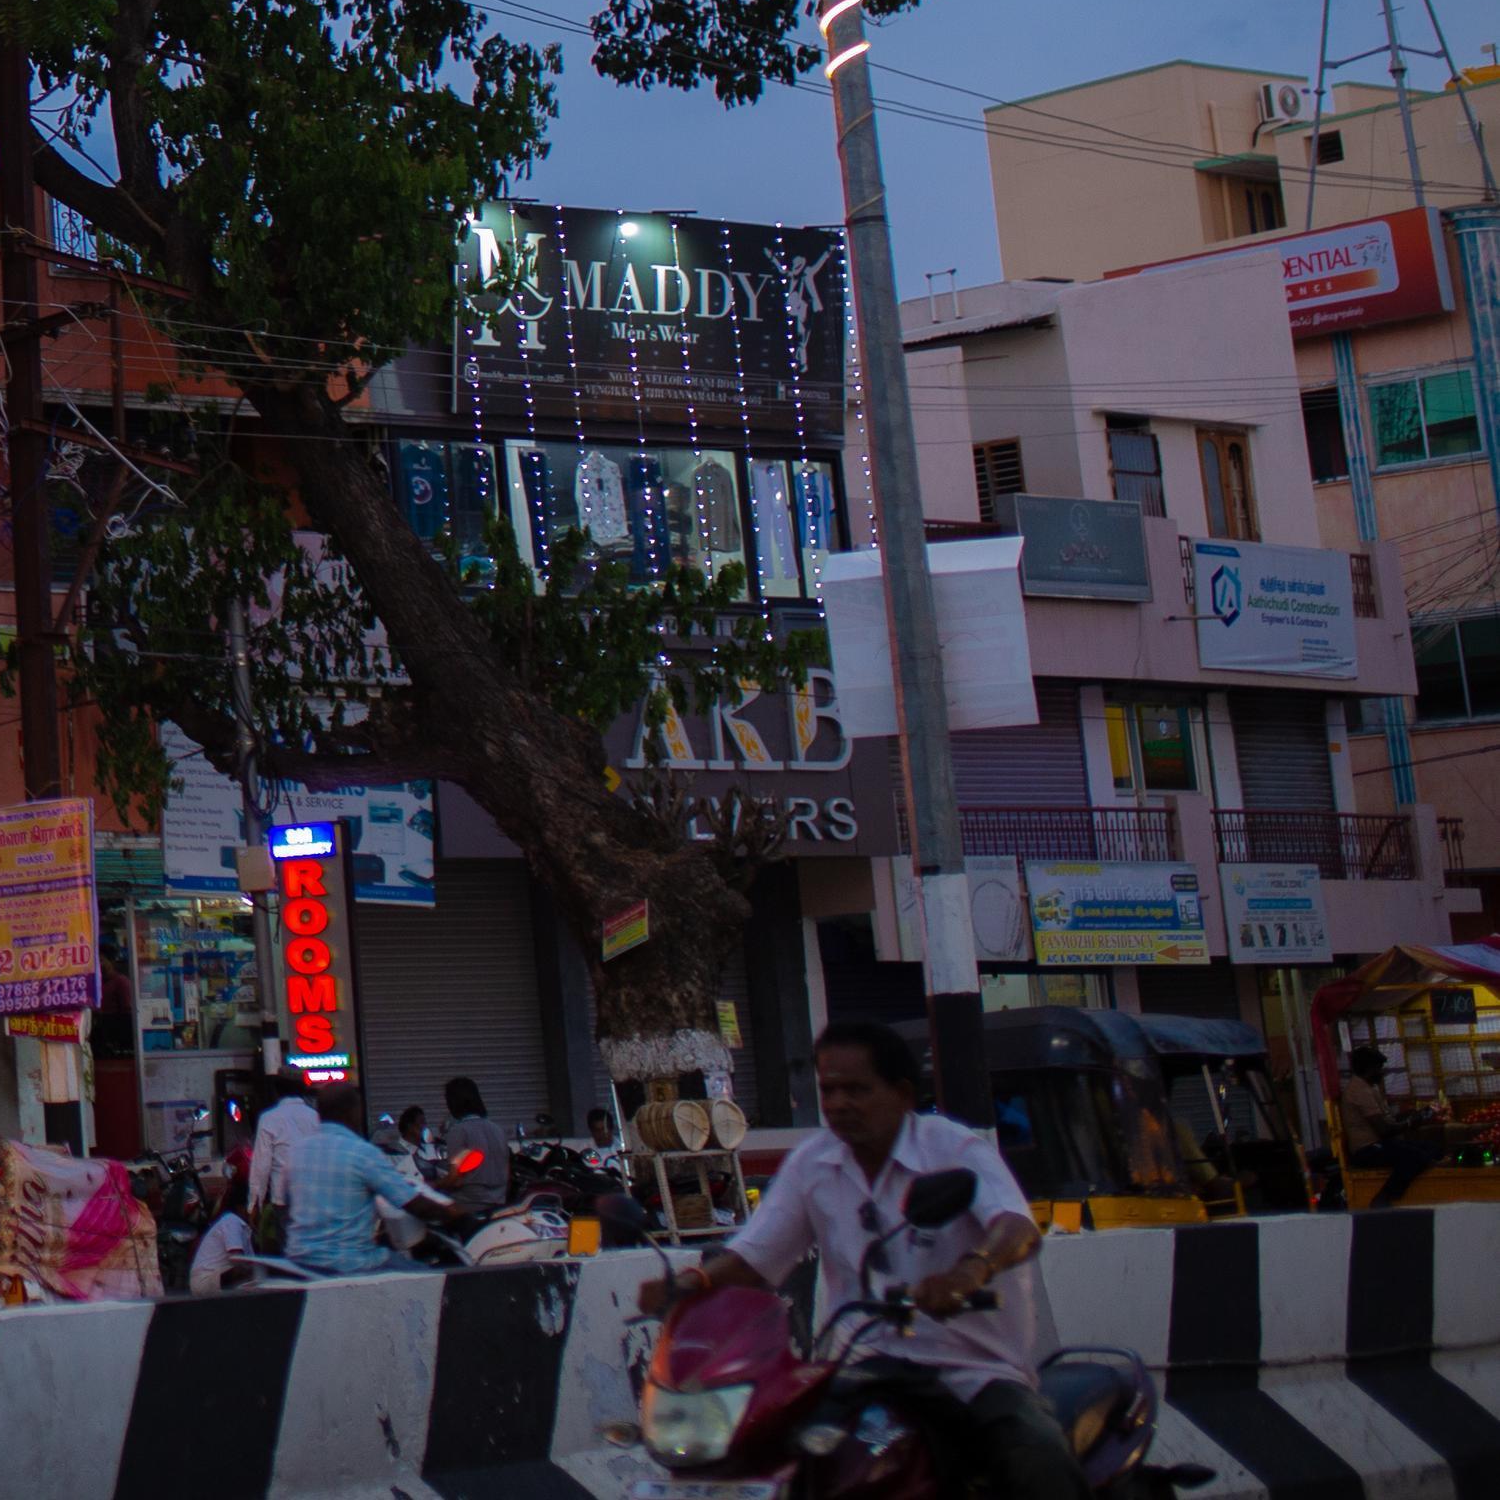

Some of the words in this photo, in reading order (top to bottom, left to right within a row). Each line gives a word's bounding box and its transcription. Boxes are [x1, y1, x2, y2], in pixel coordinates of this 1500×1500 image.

[1282, 246, 1358, 278] ENTIAL
[561, 258, 773, 322] MADDY
[1290, 599, 1341, 617] Construction
[305, 797, 344, 810] SERVICE
[282, 859, 338, 1053] ROOMS
[43, 976, 87, 992] 17176
